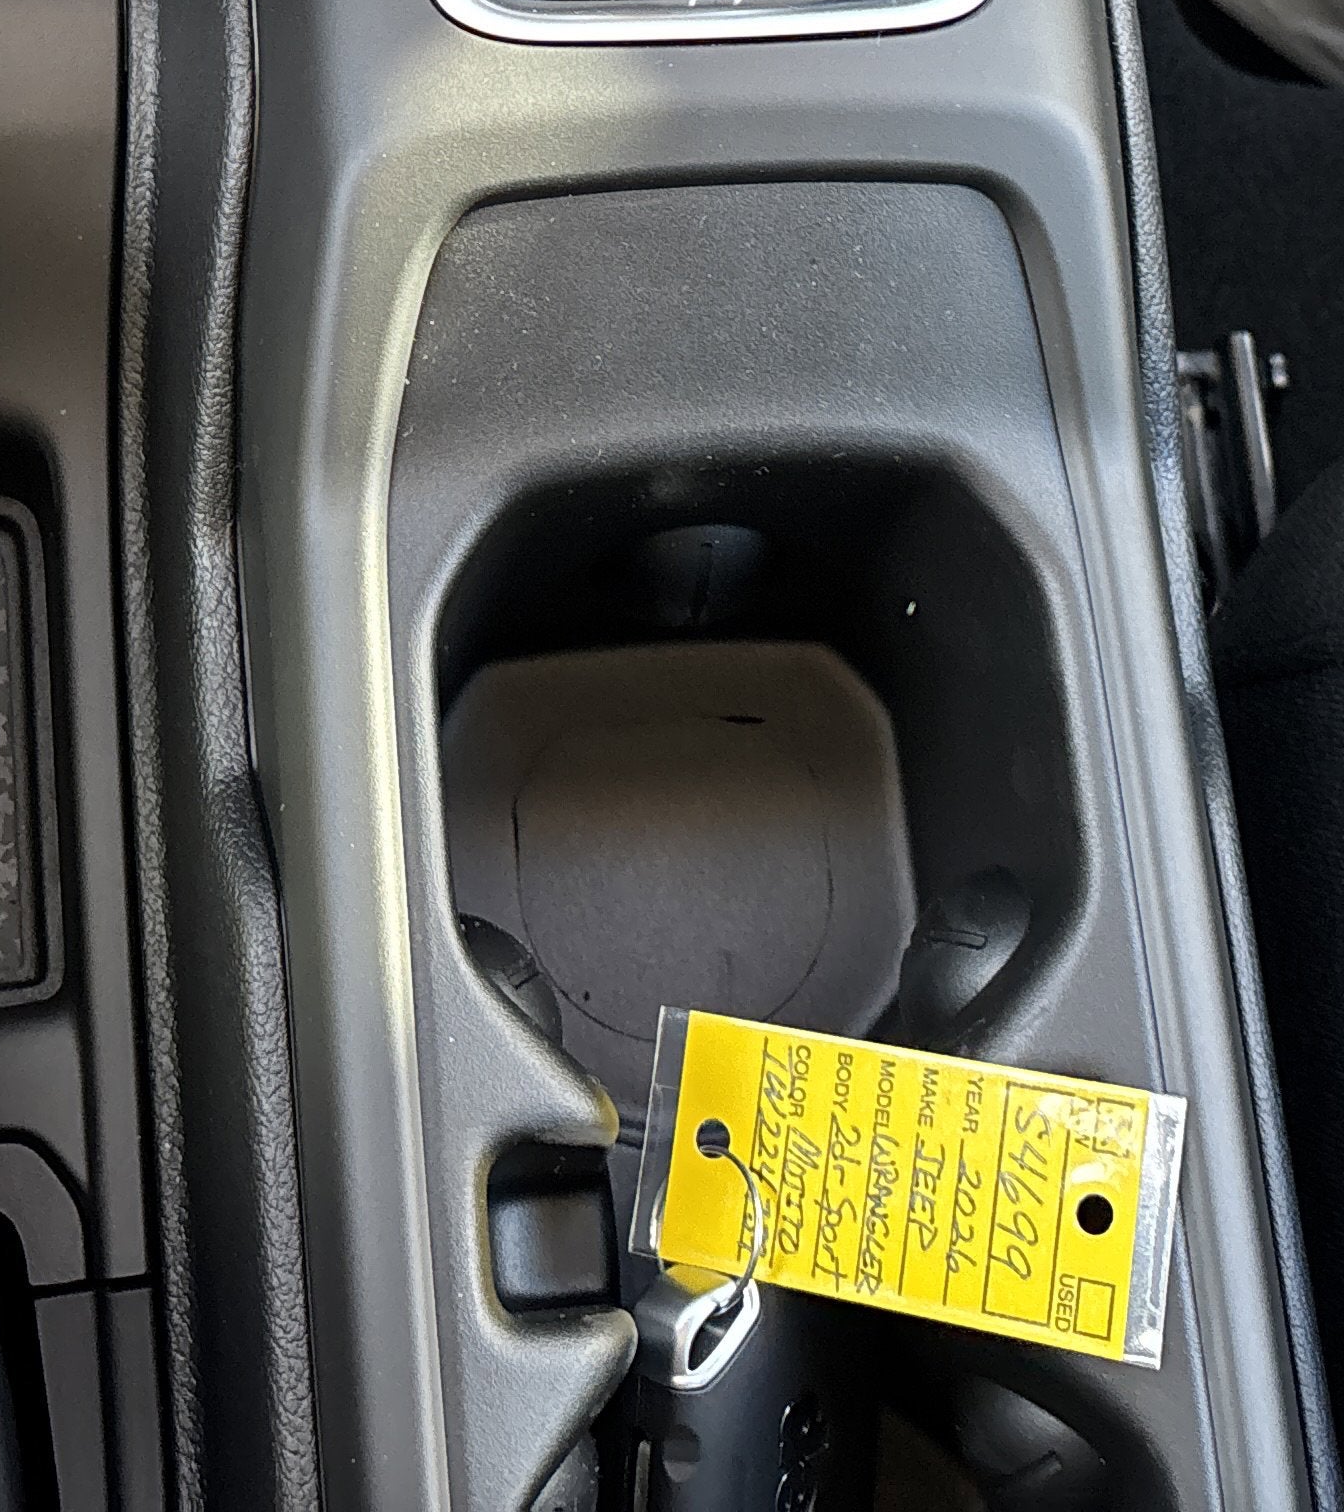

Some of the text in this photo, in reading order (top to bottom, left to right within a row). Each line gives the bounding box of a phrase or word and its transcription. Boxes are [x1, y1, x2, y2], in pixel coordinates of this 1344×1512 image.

[792, 1044, 812, 1118] COLOR
[832, 1051, 854, 1113] BODY
[908, 1068, 946, 1252] MAKE JEEP
[856, 1059, 901, 1296] MODEL WRANGLER
[946, 1076, 985, 1274] YEAR 2026
[988, 1106, 1052, 1281] S4699
[1055, 1273, 1076, 1333] USED
